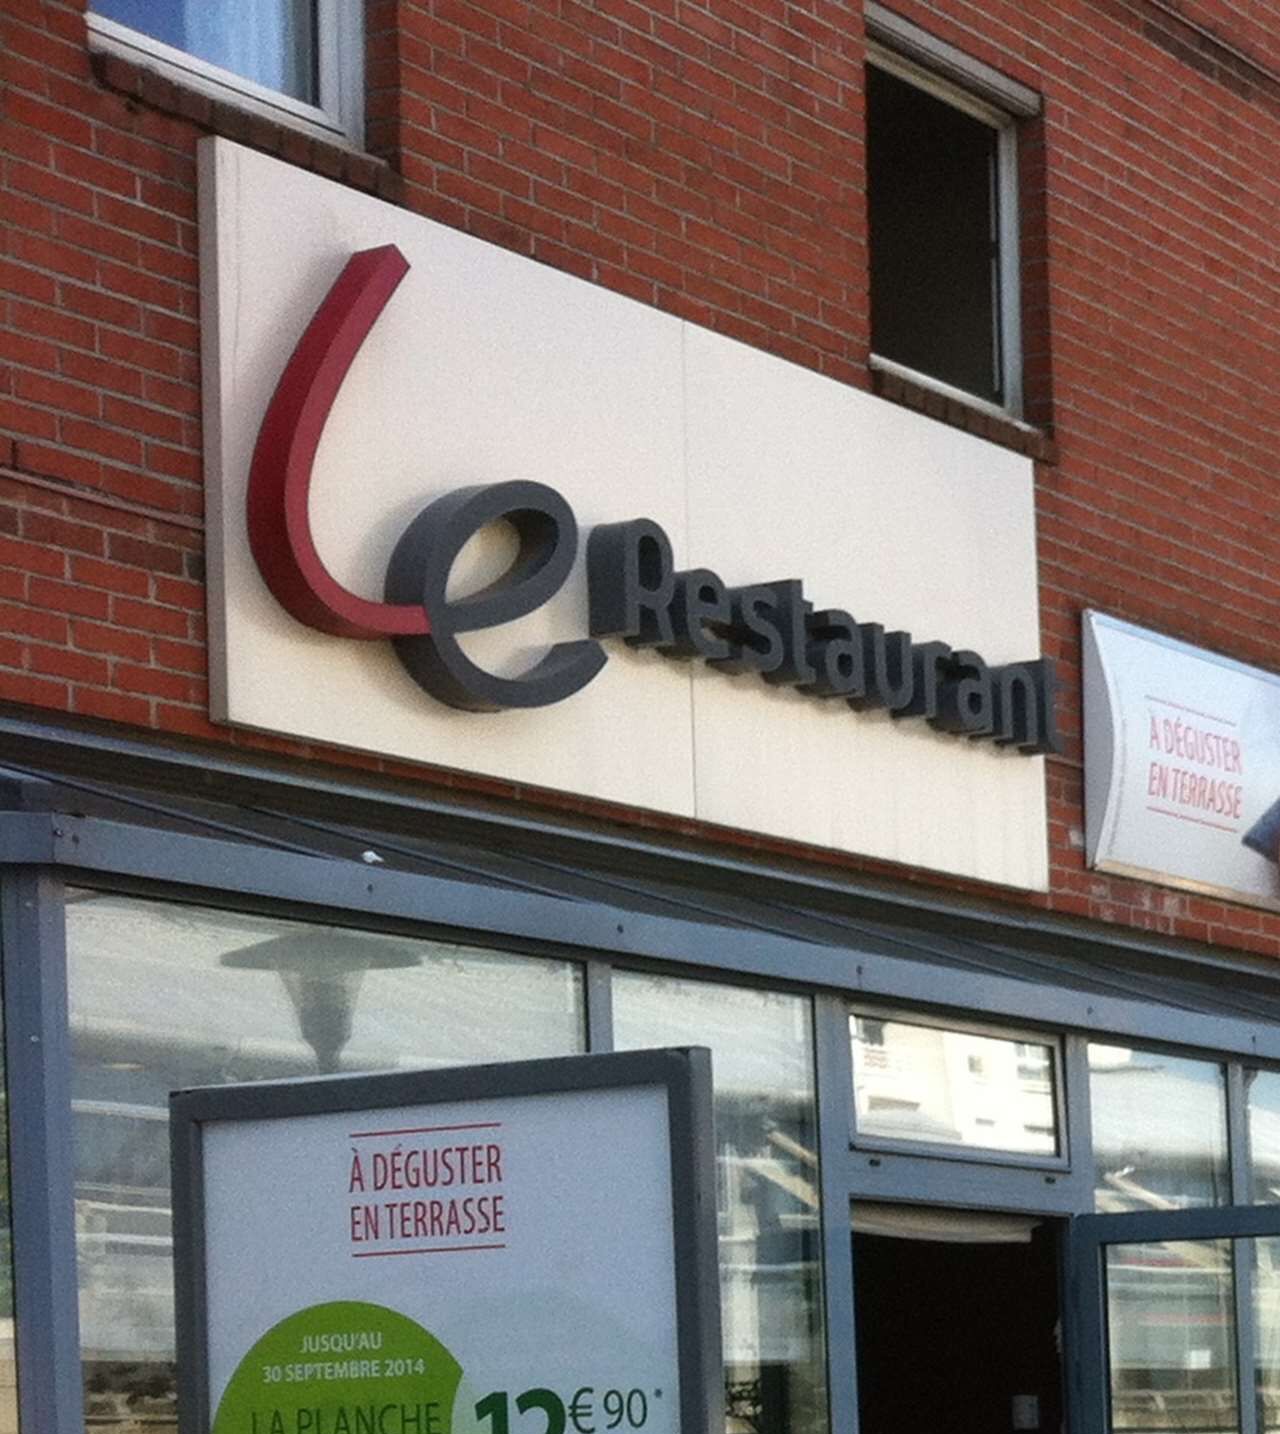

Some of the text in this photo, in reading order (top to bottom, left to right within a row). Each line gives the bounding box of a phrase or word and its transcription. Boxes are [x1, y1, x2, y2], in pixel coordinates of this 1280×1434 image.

[588, 517, 1062, 756] Restaurant
[1163, 717, 1243, 775] DÉGUSTER
[1148, 762, 1243, 819] EN TERRASSE
[373, 1143, 502, 1191] DÉGUSTER
[351, 1196, 505, 1242] EN TERRASSE
[262, 1358, 425, 1383] 30 SEPTEMBRE 2014
